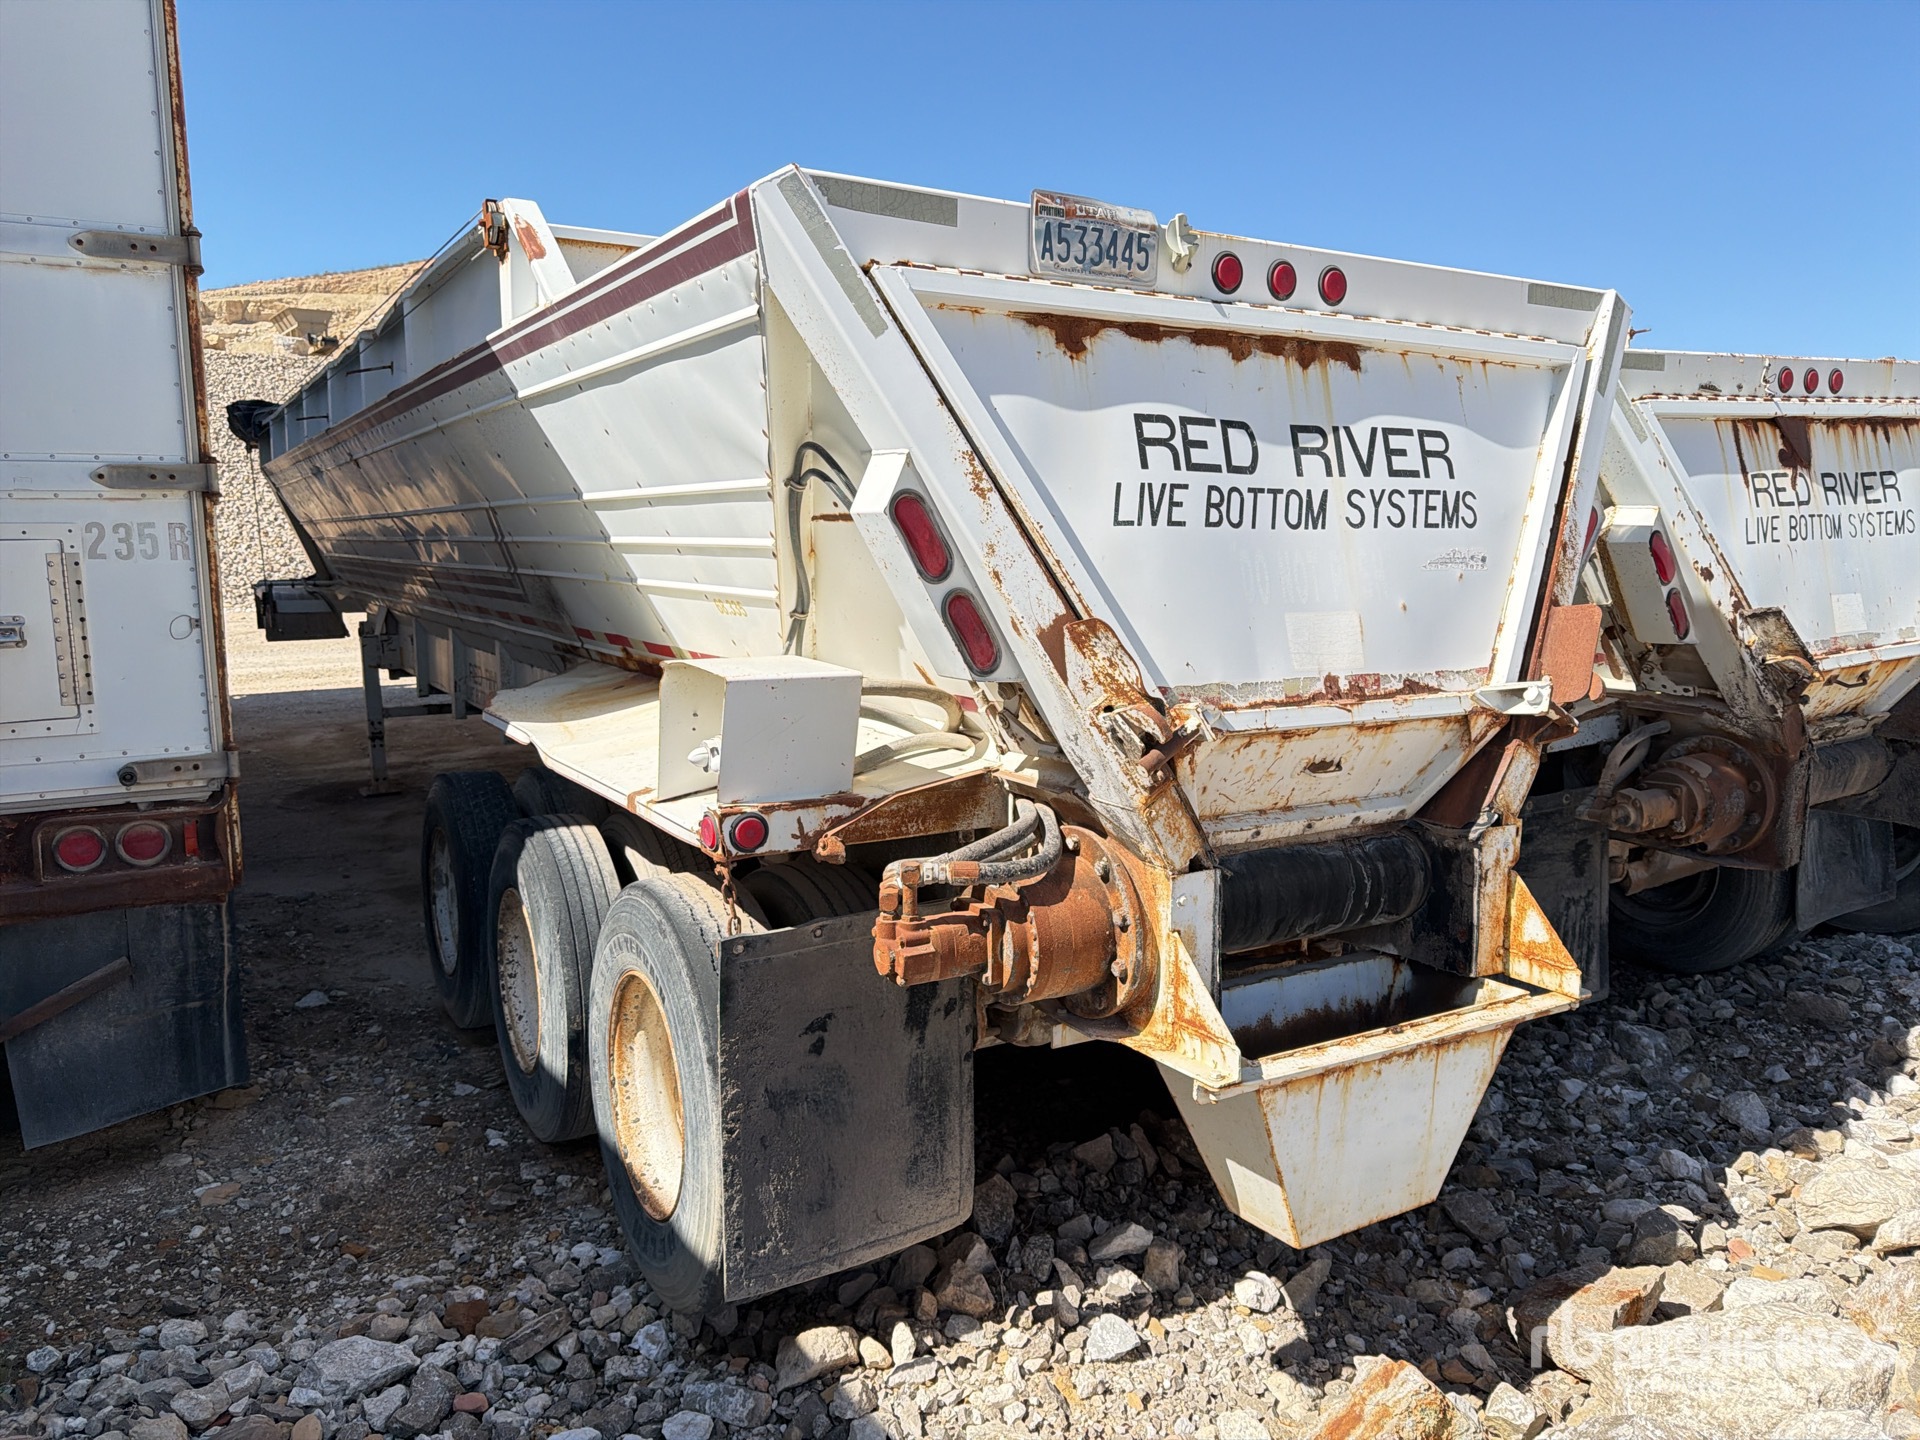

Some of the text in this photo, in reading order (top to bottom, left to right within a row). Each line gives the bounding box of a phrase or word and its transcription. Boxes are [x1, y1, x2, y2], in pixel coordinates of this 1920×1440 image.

[1075, 204, 1118, 221] UTAH
[1040, 220, 1151, 272] A533445
[1133, 412, 1456, 480] RED RIVER
[1112, 481, 1478, 531] LIVE BOTTOM SYSTEMS
[1750, 470, 1902, 508] RED RIVER
[84, 521, 192, 561] 235 R
[1745, 508, 1916, 545] LIVE BOTTOM SYSTEMS
